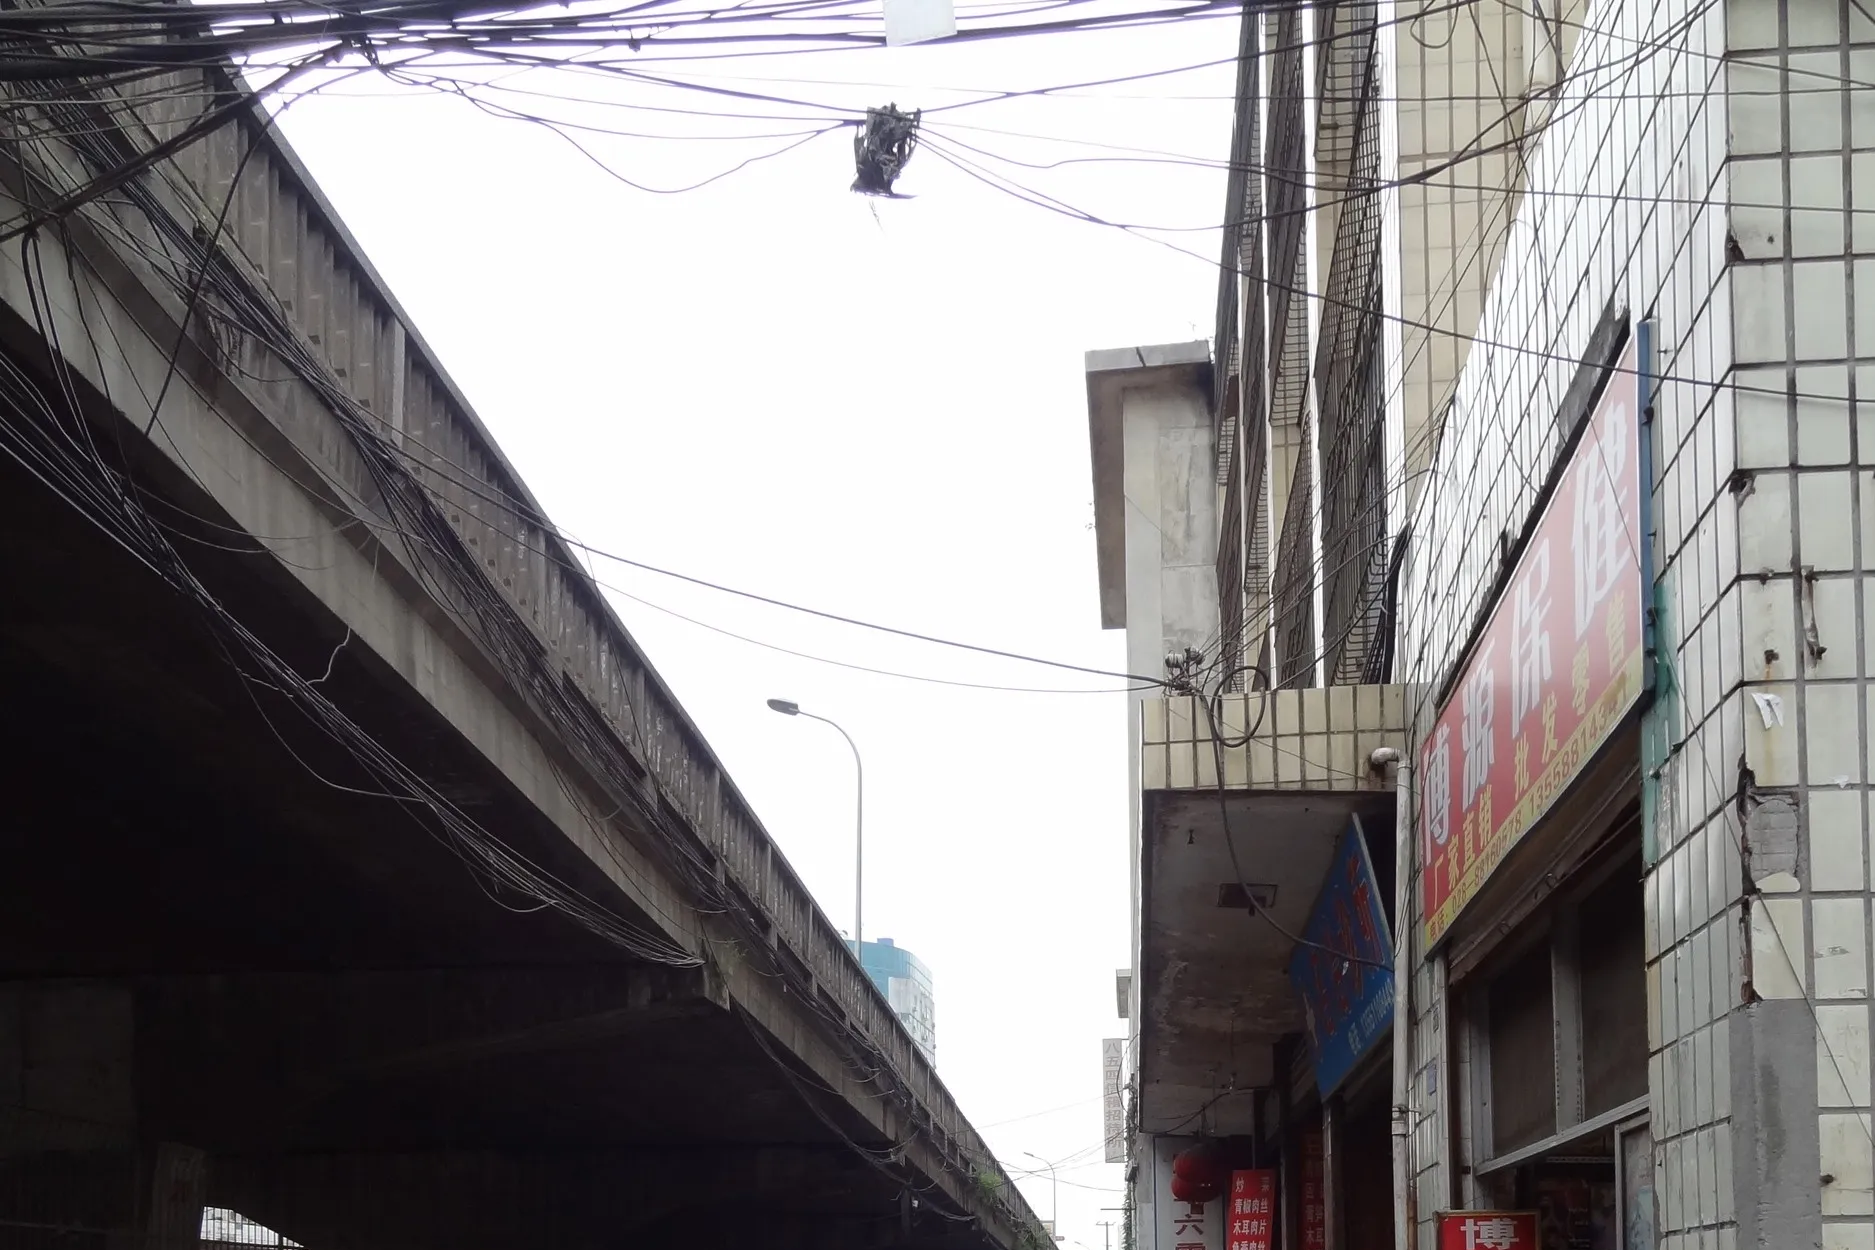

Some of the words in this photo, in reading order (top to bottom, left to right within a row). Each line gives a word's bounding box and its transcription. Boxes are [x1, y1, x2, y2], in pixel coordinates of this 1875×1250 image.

[1422, 401, 1632, 866] 博源保健
[1434, 784, 1492, 909] 厂家直销
[1232, 1219, 1267, 1236] 木耳肉片
[1234, 1198, 1268, 1215] 青椒肉丝
